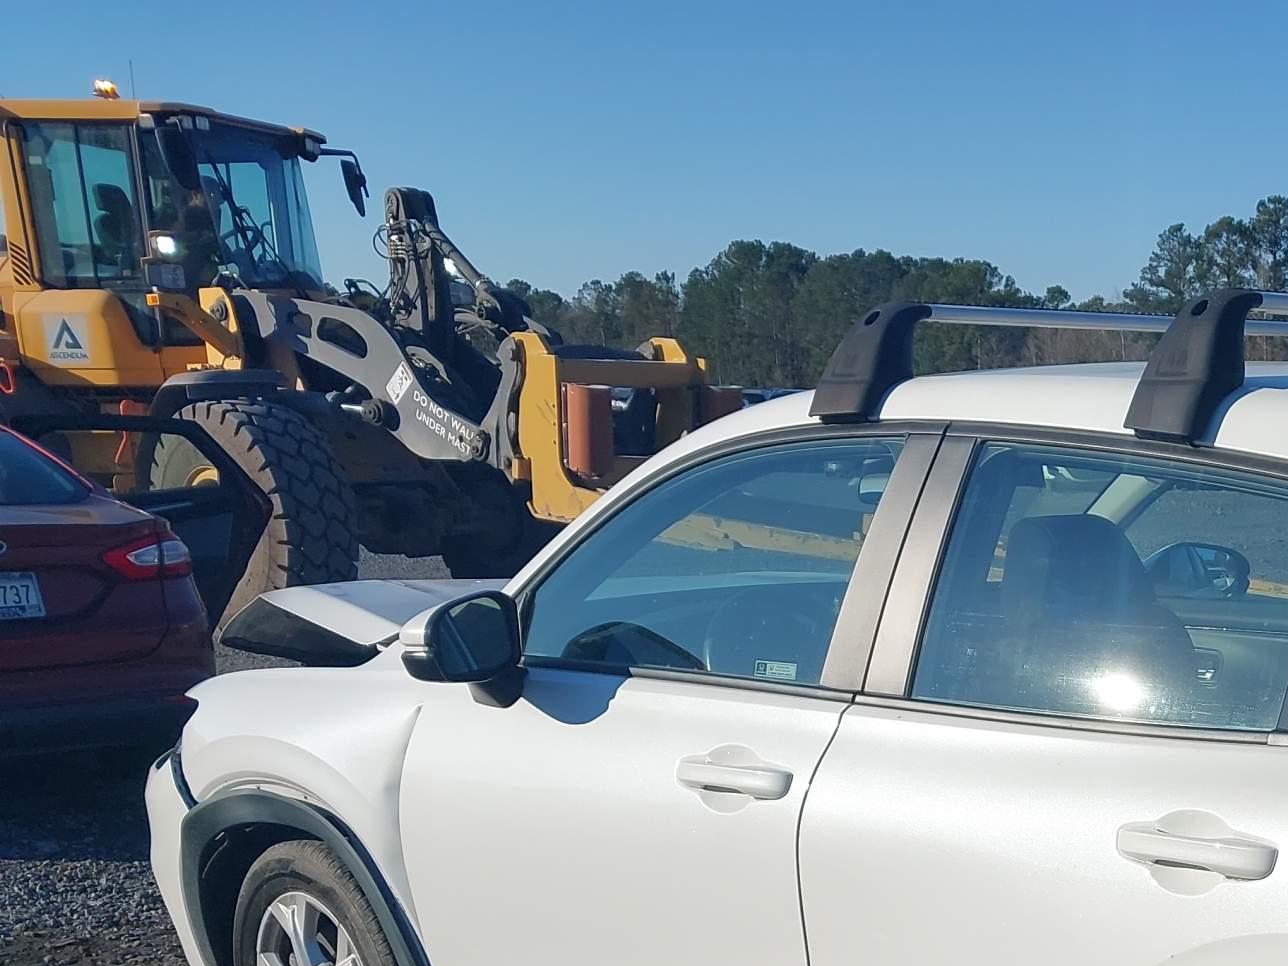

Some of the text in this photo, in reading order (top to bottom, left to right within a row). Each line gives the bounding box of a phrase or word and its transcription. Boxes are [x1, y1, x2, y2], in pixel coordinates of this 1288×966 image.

[413, 390, 428, 407] DO
[428, 404, 450, 422] NOT
[416, 409, 471, 455] UNDER MAST
